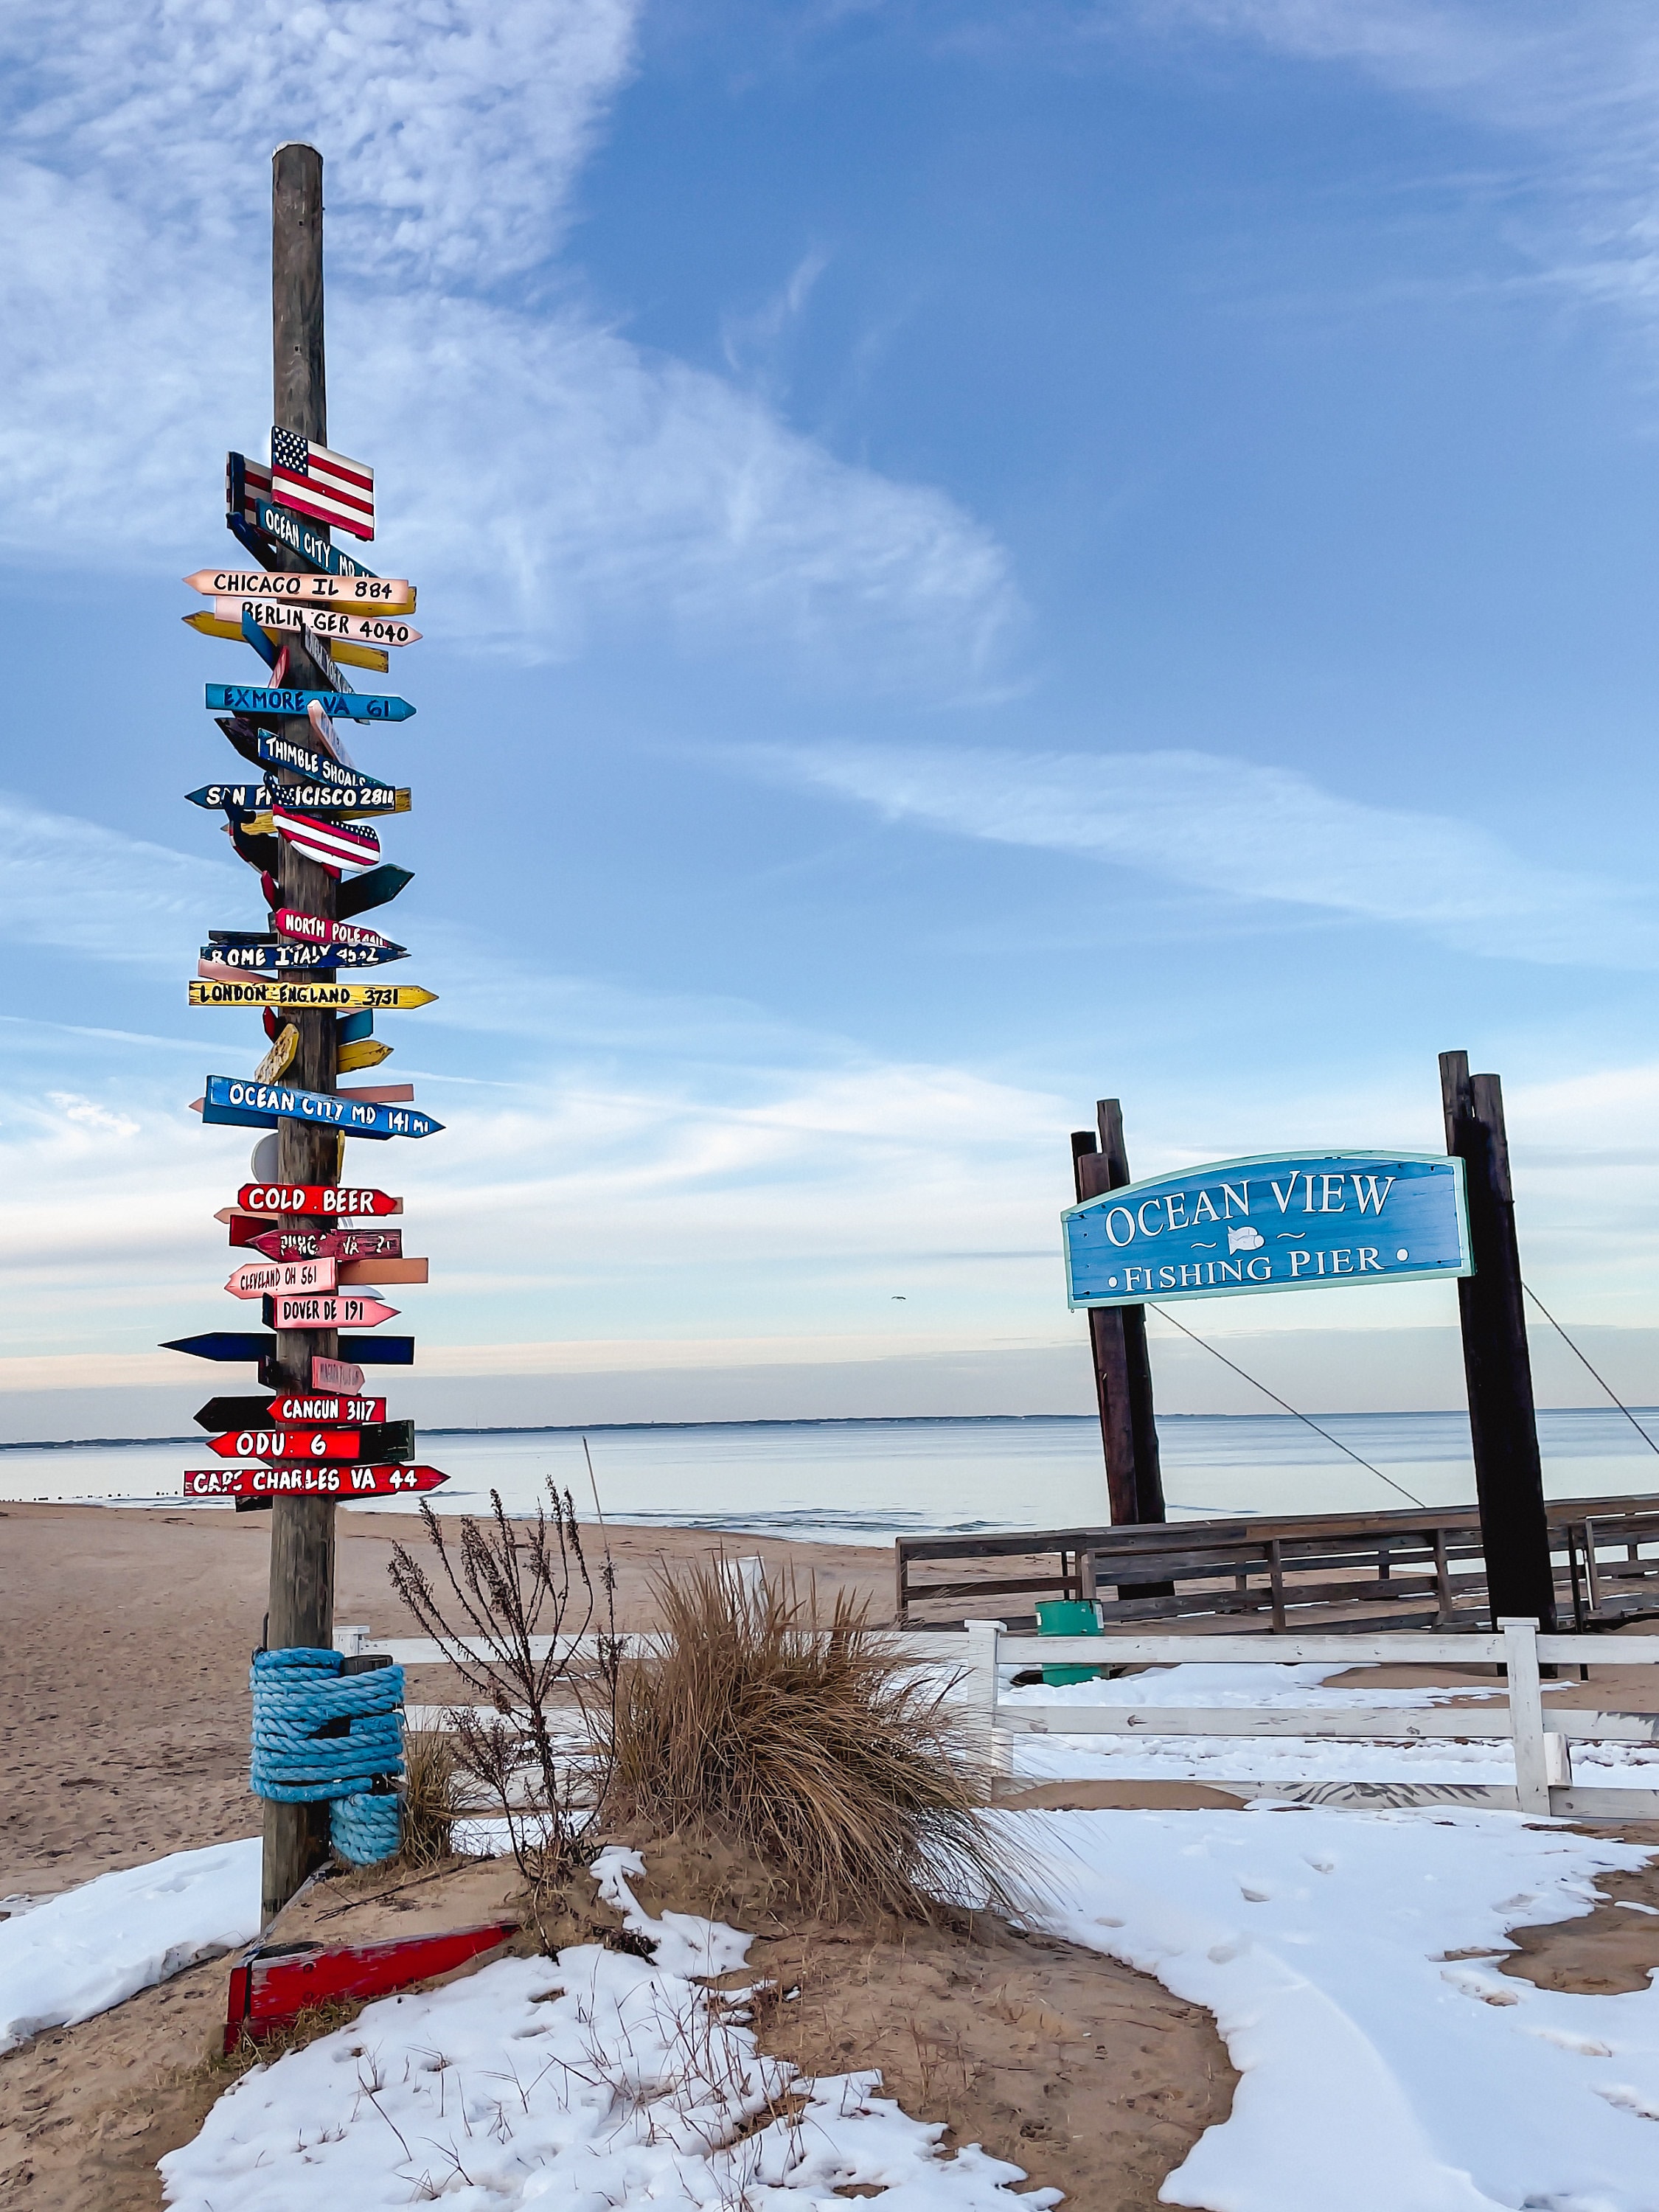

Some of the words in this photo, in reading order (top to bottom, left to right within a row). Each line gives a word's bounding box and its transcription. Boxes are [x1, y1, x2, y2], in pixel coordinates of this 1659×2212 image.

[265, 509, 300, 549] OCEAN
[304, 532, 330, 568] CITY
[339, 554, 355, 577] MD
[214, 574, 301, 594] CHICAGO
[312, 578, 339, 596] IL
[355, 581, 392, 599] 884
[242, 602, 305, 627] BERLIN
[313, 612, 349, 634] GER
[359, 621, 408, 643] 4040
[224, 686, 305, 712] EXMORE
[323, 693, 350, 715] VA
[366, 699, 389, 717] 61
[266, 737, 319, 773] THIMBLE
[206, 786, 245, 806] SN
[255, 785, 357, 807] FCISCO
[360, 787, 394, 805] 2811
[285, 914, 325, 938] NORTH
[332, 922, 360, 944] POLE
[212, 947, 265, 965] ROME
[275, 944, 331, 966] ITALY
[201, 984, 267, 1003] LONDON
[279, 984, 350, 1004] ENGLAND
[362, 988, 398, 1006] 3731
[229, 1082, 295, 1112] OCEAN
[302, 1098, 343, 1121] CITY
[352, 1106, 376, 1124] MD
[388, 1111, 409, 1133] 141
[413, 1119, 428, 1133] MI
[248, 1187, 306, 1210] COLD
[323, 1189, 375, 1214] BEER
[1105, 1179, 1251, 1248] OCEAN
[1270, 1170, 1396, 1216] VIEW
[240, 1267, 280, 1290] CLEVELAND
[285, 1267, 296, 1285] OH
[301, 1265, 316, 1285] 561
[1122, 1256, 1273, 1293] FISHING
[1287, 1247, 1385, 1278] PIER
[283, 1300, 319, 1321] DOVER
[324, 1300, 337, 1321] DE
[345, 1300, 363, 1321] 191
[347, 1400, 375, 1421] 3117
[236, 1433, 285, 1455] ODU
[310, 1433, 327, 1455] 6
[253, 1468, 340, 1490] CHARLES
[351, 1468, 376, 1489] VA
[389, 1470, 418, 1489] 44
